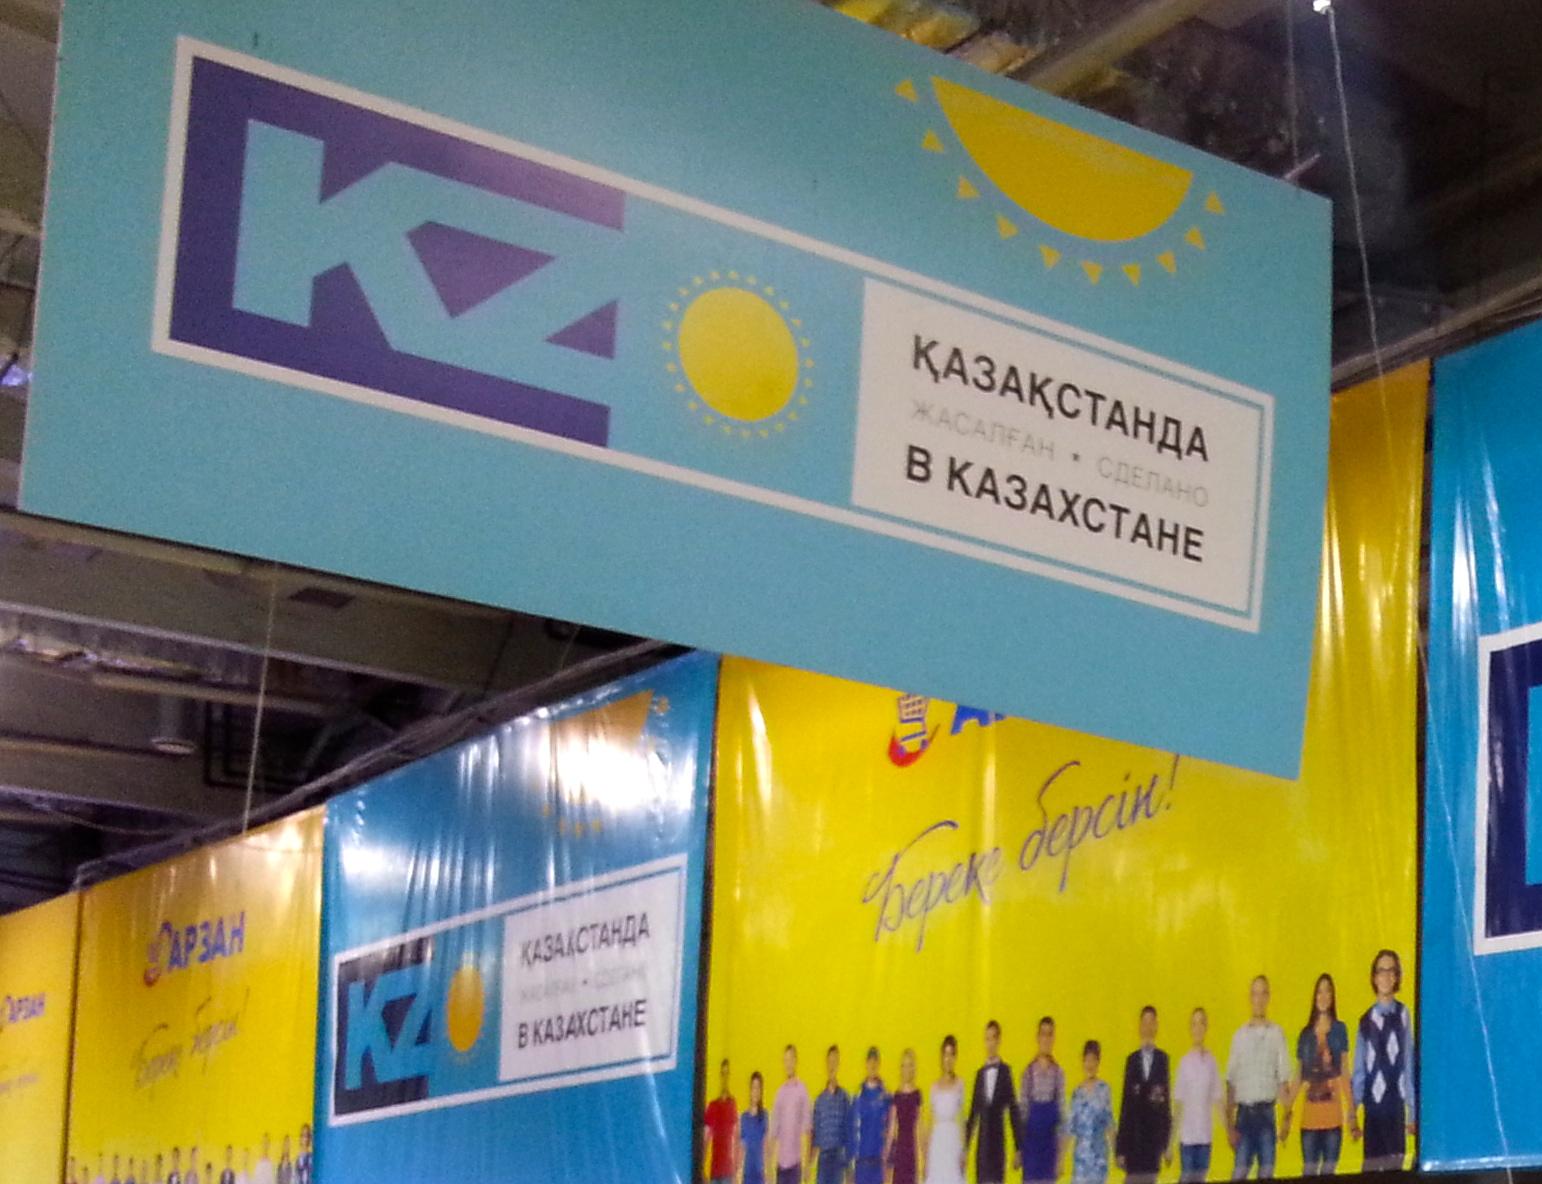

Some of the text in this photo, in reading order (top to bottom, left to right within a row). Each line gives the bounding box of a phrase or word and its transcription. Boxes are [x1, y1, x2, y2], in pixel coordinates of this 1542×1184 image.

[231, 117, 625, 408] KZ
[911, 400, 1210, 508] ЖАСАЛҒАН СДЕЛАНО
[912, 334, 1209, 462] ҚАЗАҚСТАНДА
[906, 444, 1205, 563] В КАЗАХСТАНЕ
[518, 999, 648, 1050] В КАЗАХСТАНЕ
